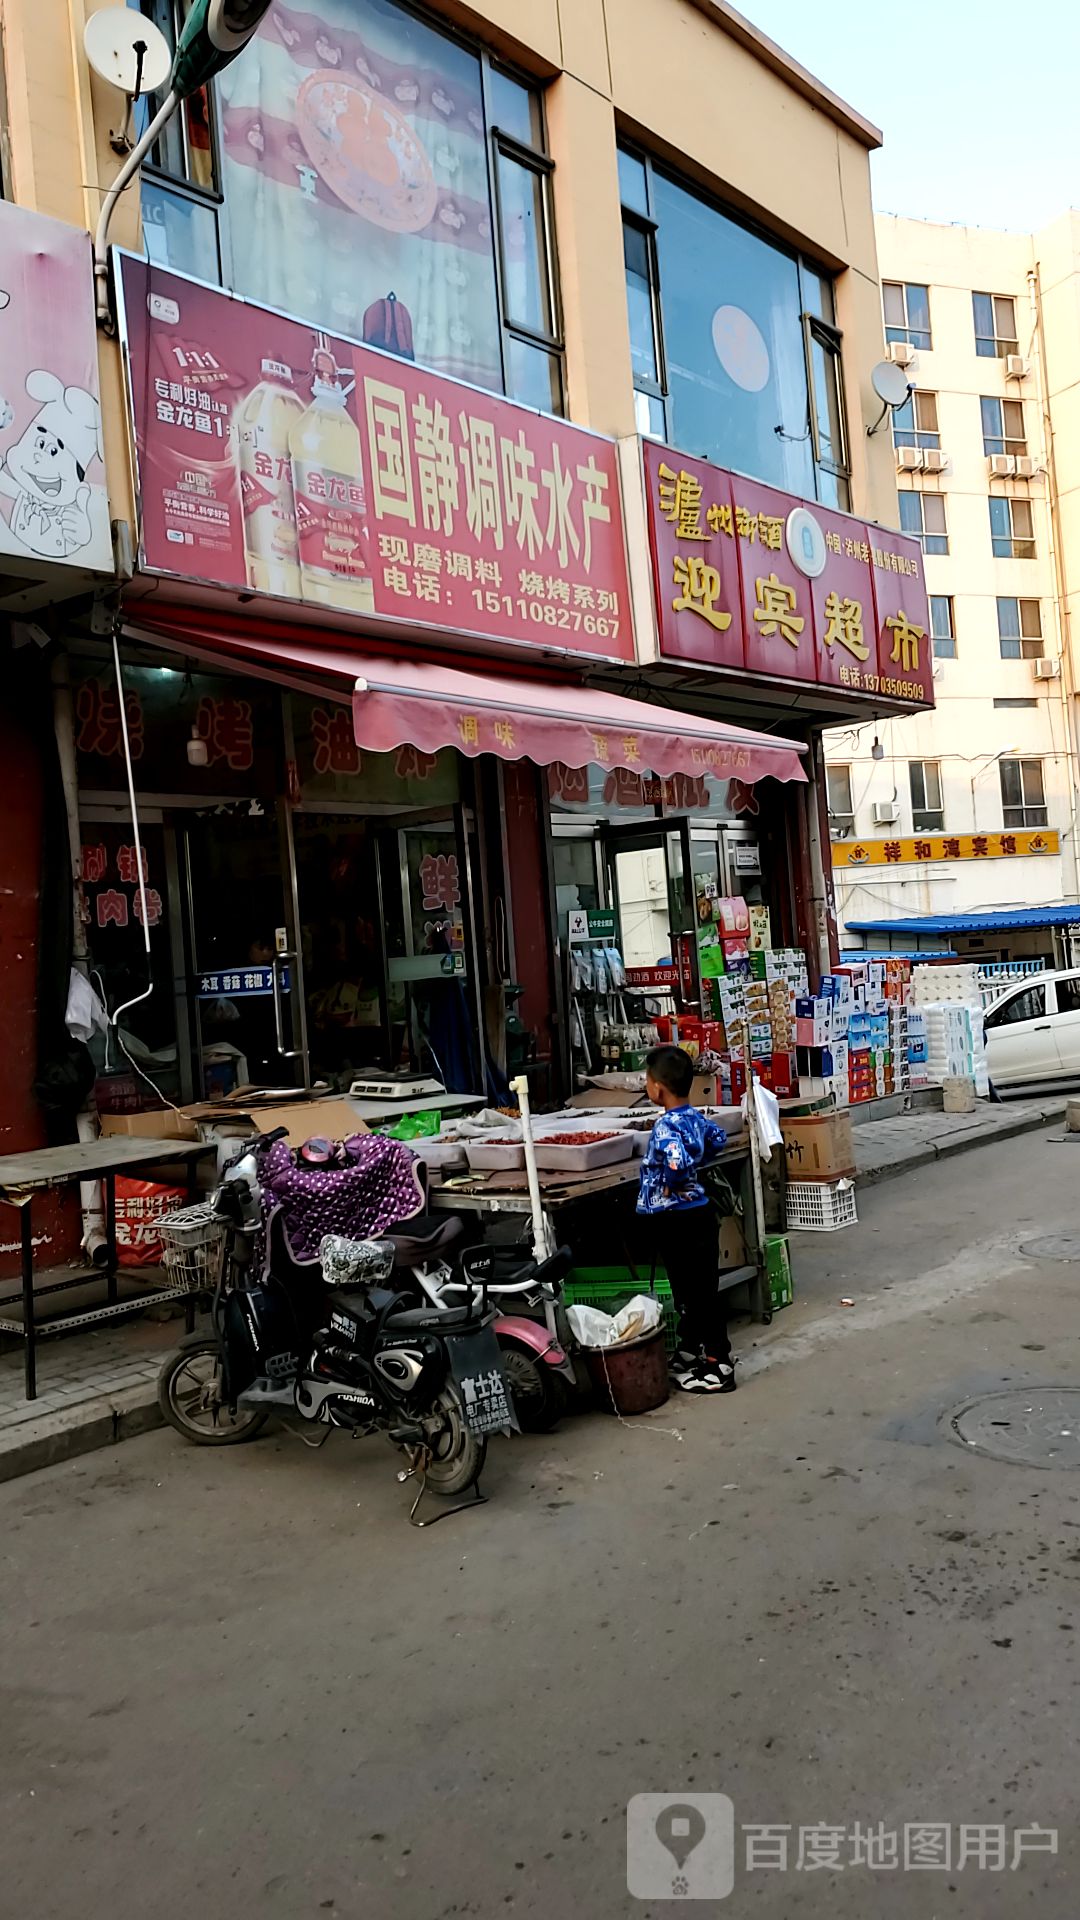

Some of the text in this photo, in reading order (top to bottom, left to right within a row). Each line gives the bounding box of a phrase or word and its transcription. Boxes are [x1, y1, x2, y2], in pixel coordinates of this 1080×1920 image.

[364, 376, 611, 575] 国静调味水产
[378, 533, 619, 616] 现磨调料 烧烤系列
[471, 589, 620, 639] 15110827667
[672, 555, 928, 673] 迎宾超市
[75, 677, 254, 771] 烧烤
[458, 715, 516, 749] 调味
[84, 888, 163, 928] 肉卷
[201, 977, 219, 992] 木耳
[785, 1140, 804, 1163] 竹
